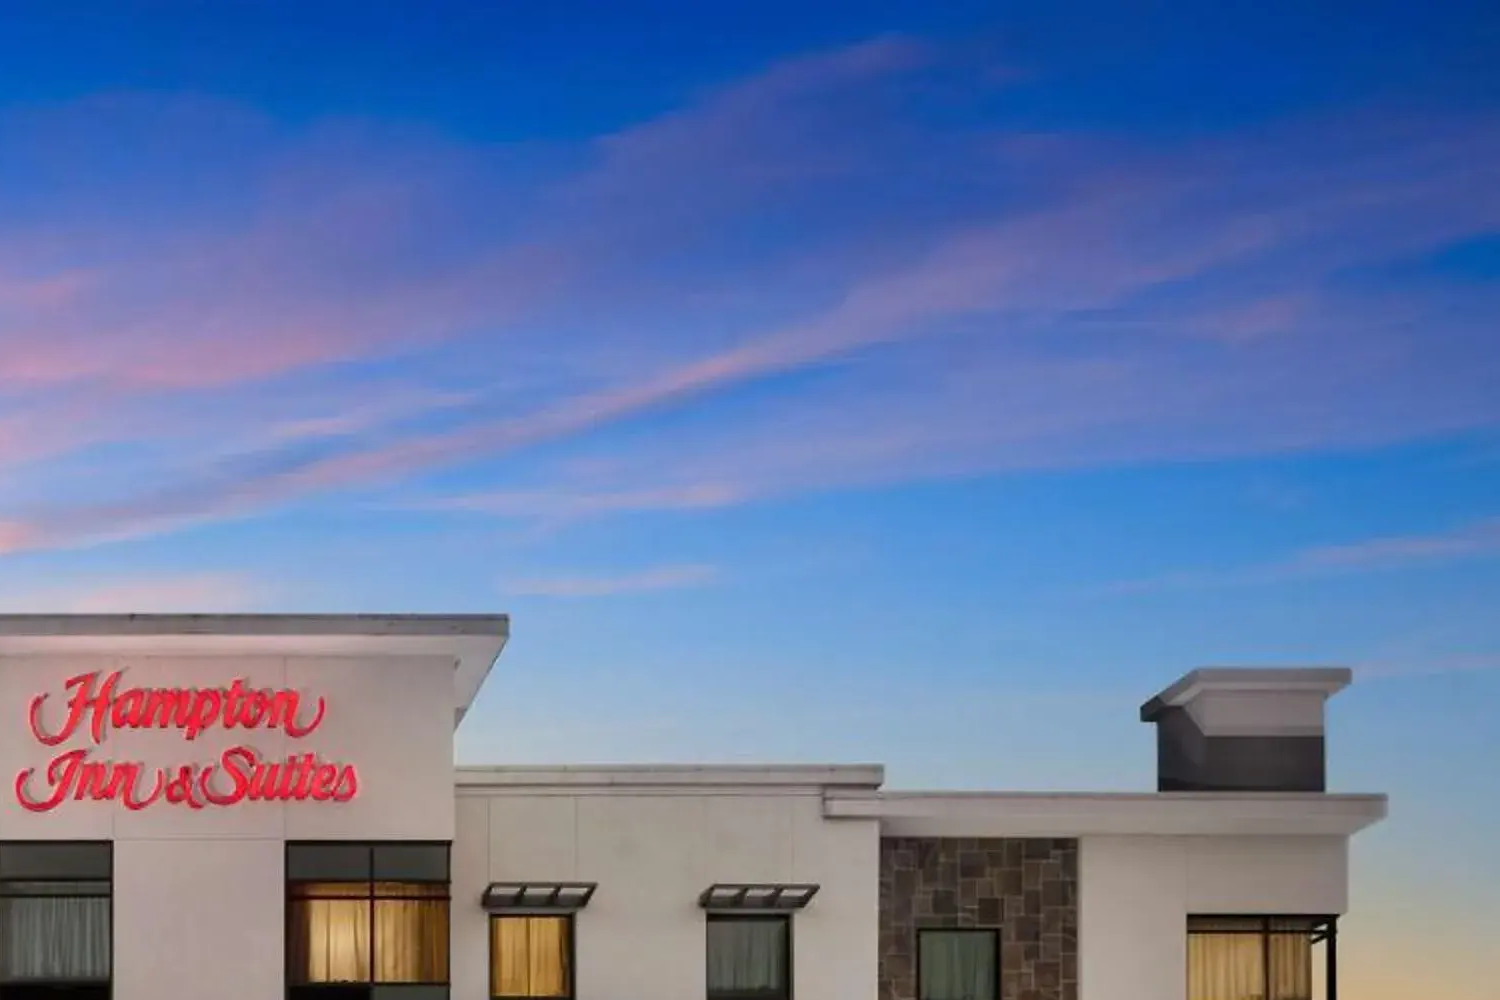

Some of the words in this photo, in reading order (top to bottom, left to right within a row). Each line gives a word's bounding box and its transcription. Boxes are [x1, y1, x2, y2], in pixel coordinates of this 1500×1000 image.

[29, 670, 325, 746] Hampton
[15, 748, 163, 812] Inn
[165, 764, 204, 809] &
[200, 746, 358, 806] Suites
